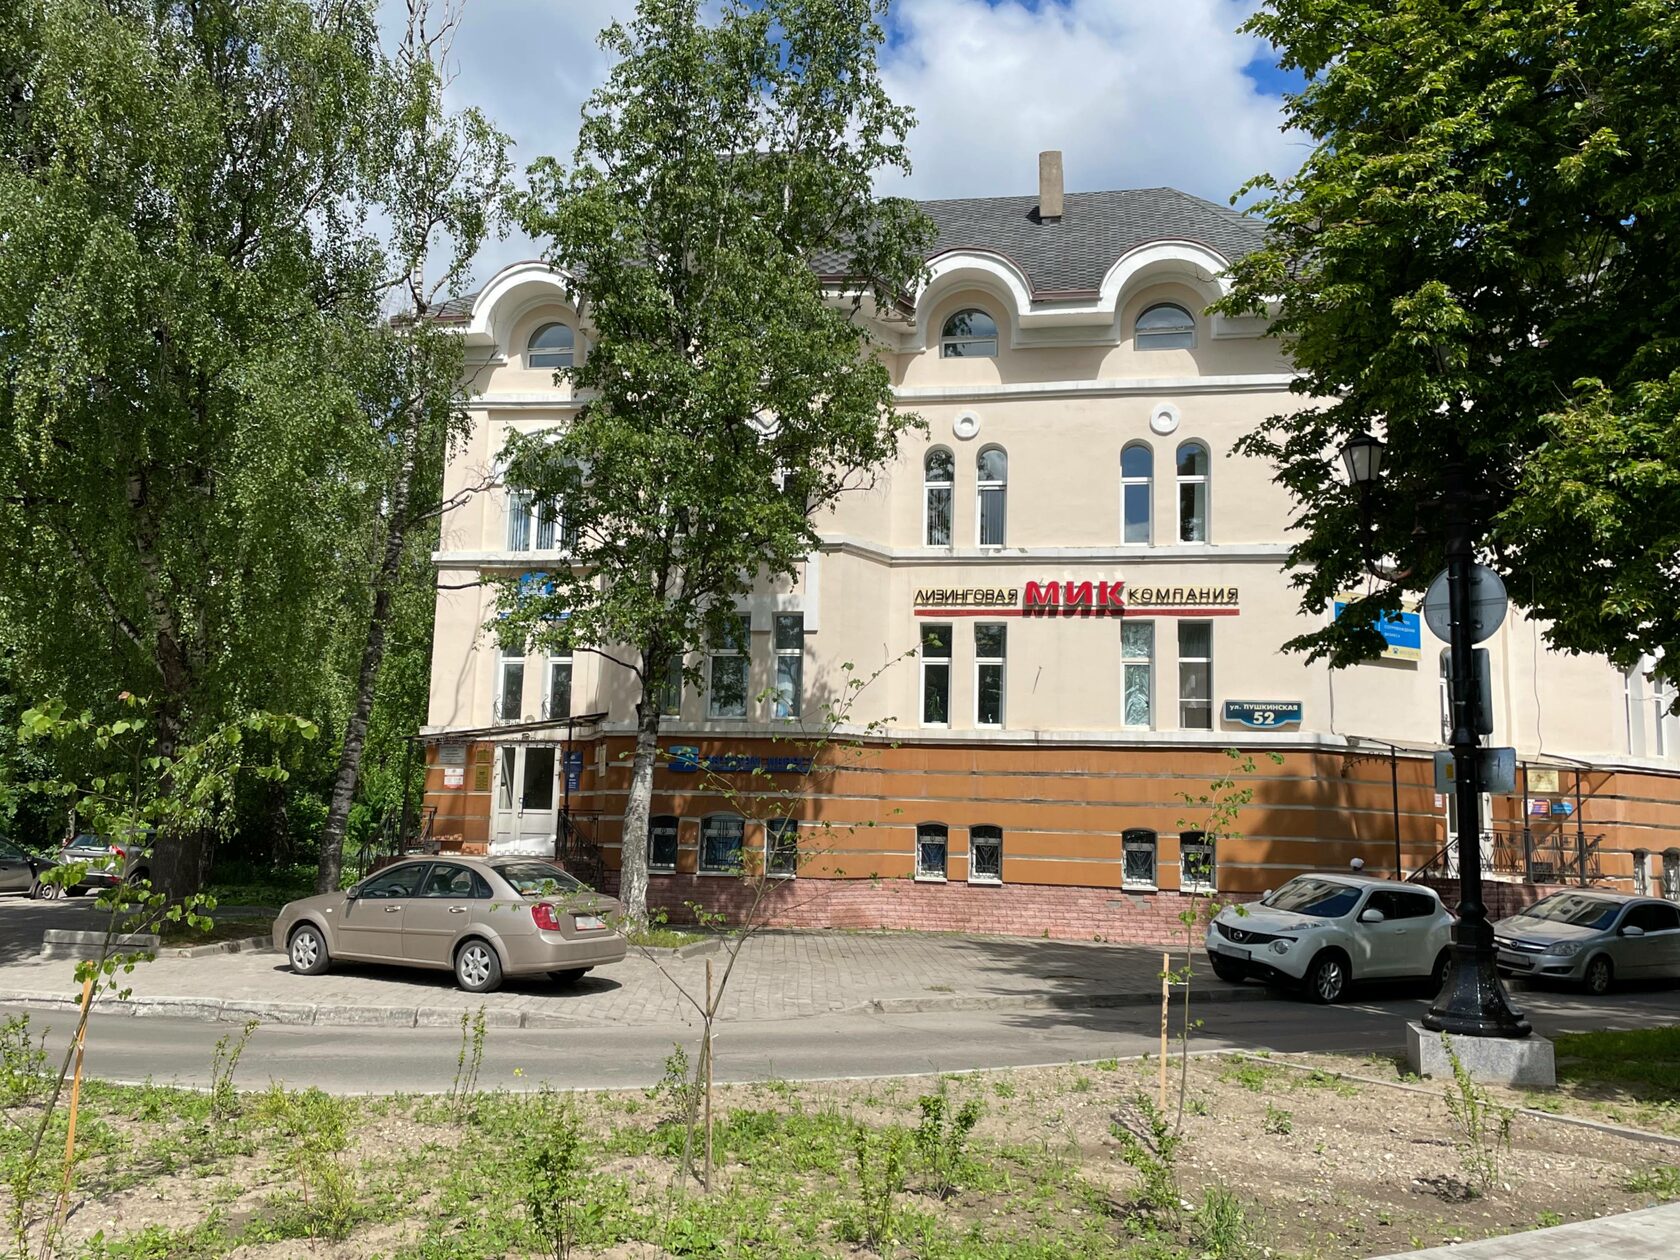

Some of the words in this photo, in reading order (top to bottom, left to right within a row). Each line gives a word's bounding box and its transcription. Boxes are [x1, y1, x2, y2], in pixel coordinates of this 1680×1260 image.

[914, 588, 1018, 605] ЛИЗИНГОВАЯ
[1025, 580, 1126, 606] МИК
[1129, 588, 1239, 604] КОМПАНИЯ
[1243, 703, 1299, 711] ПУШКИНСКАЯ
[1253, 711, 1275, 725] 52
